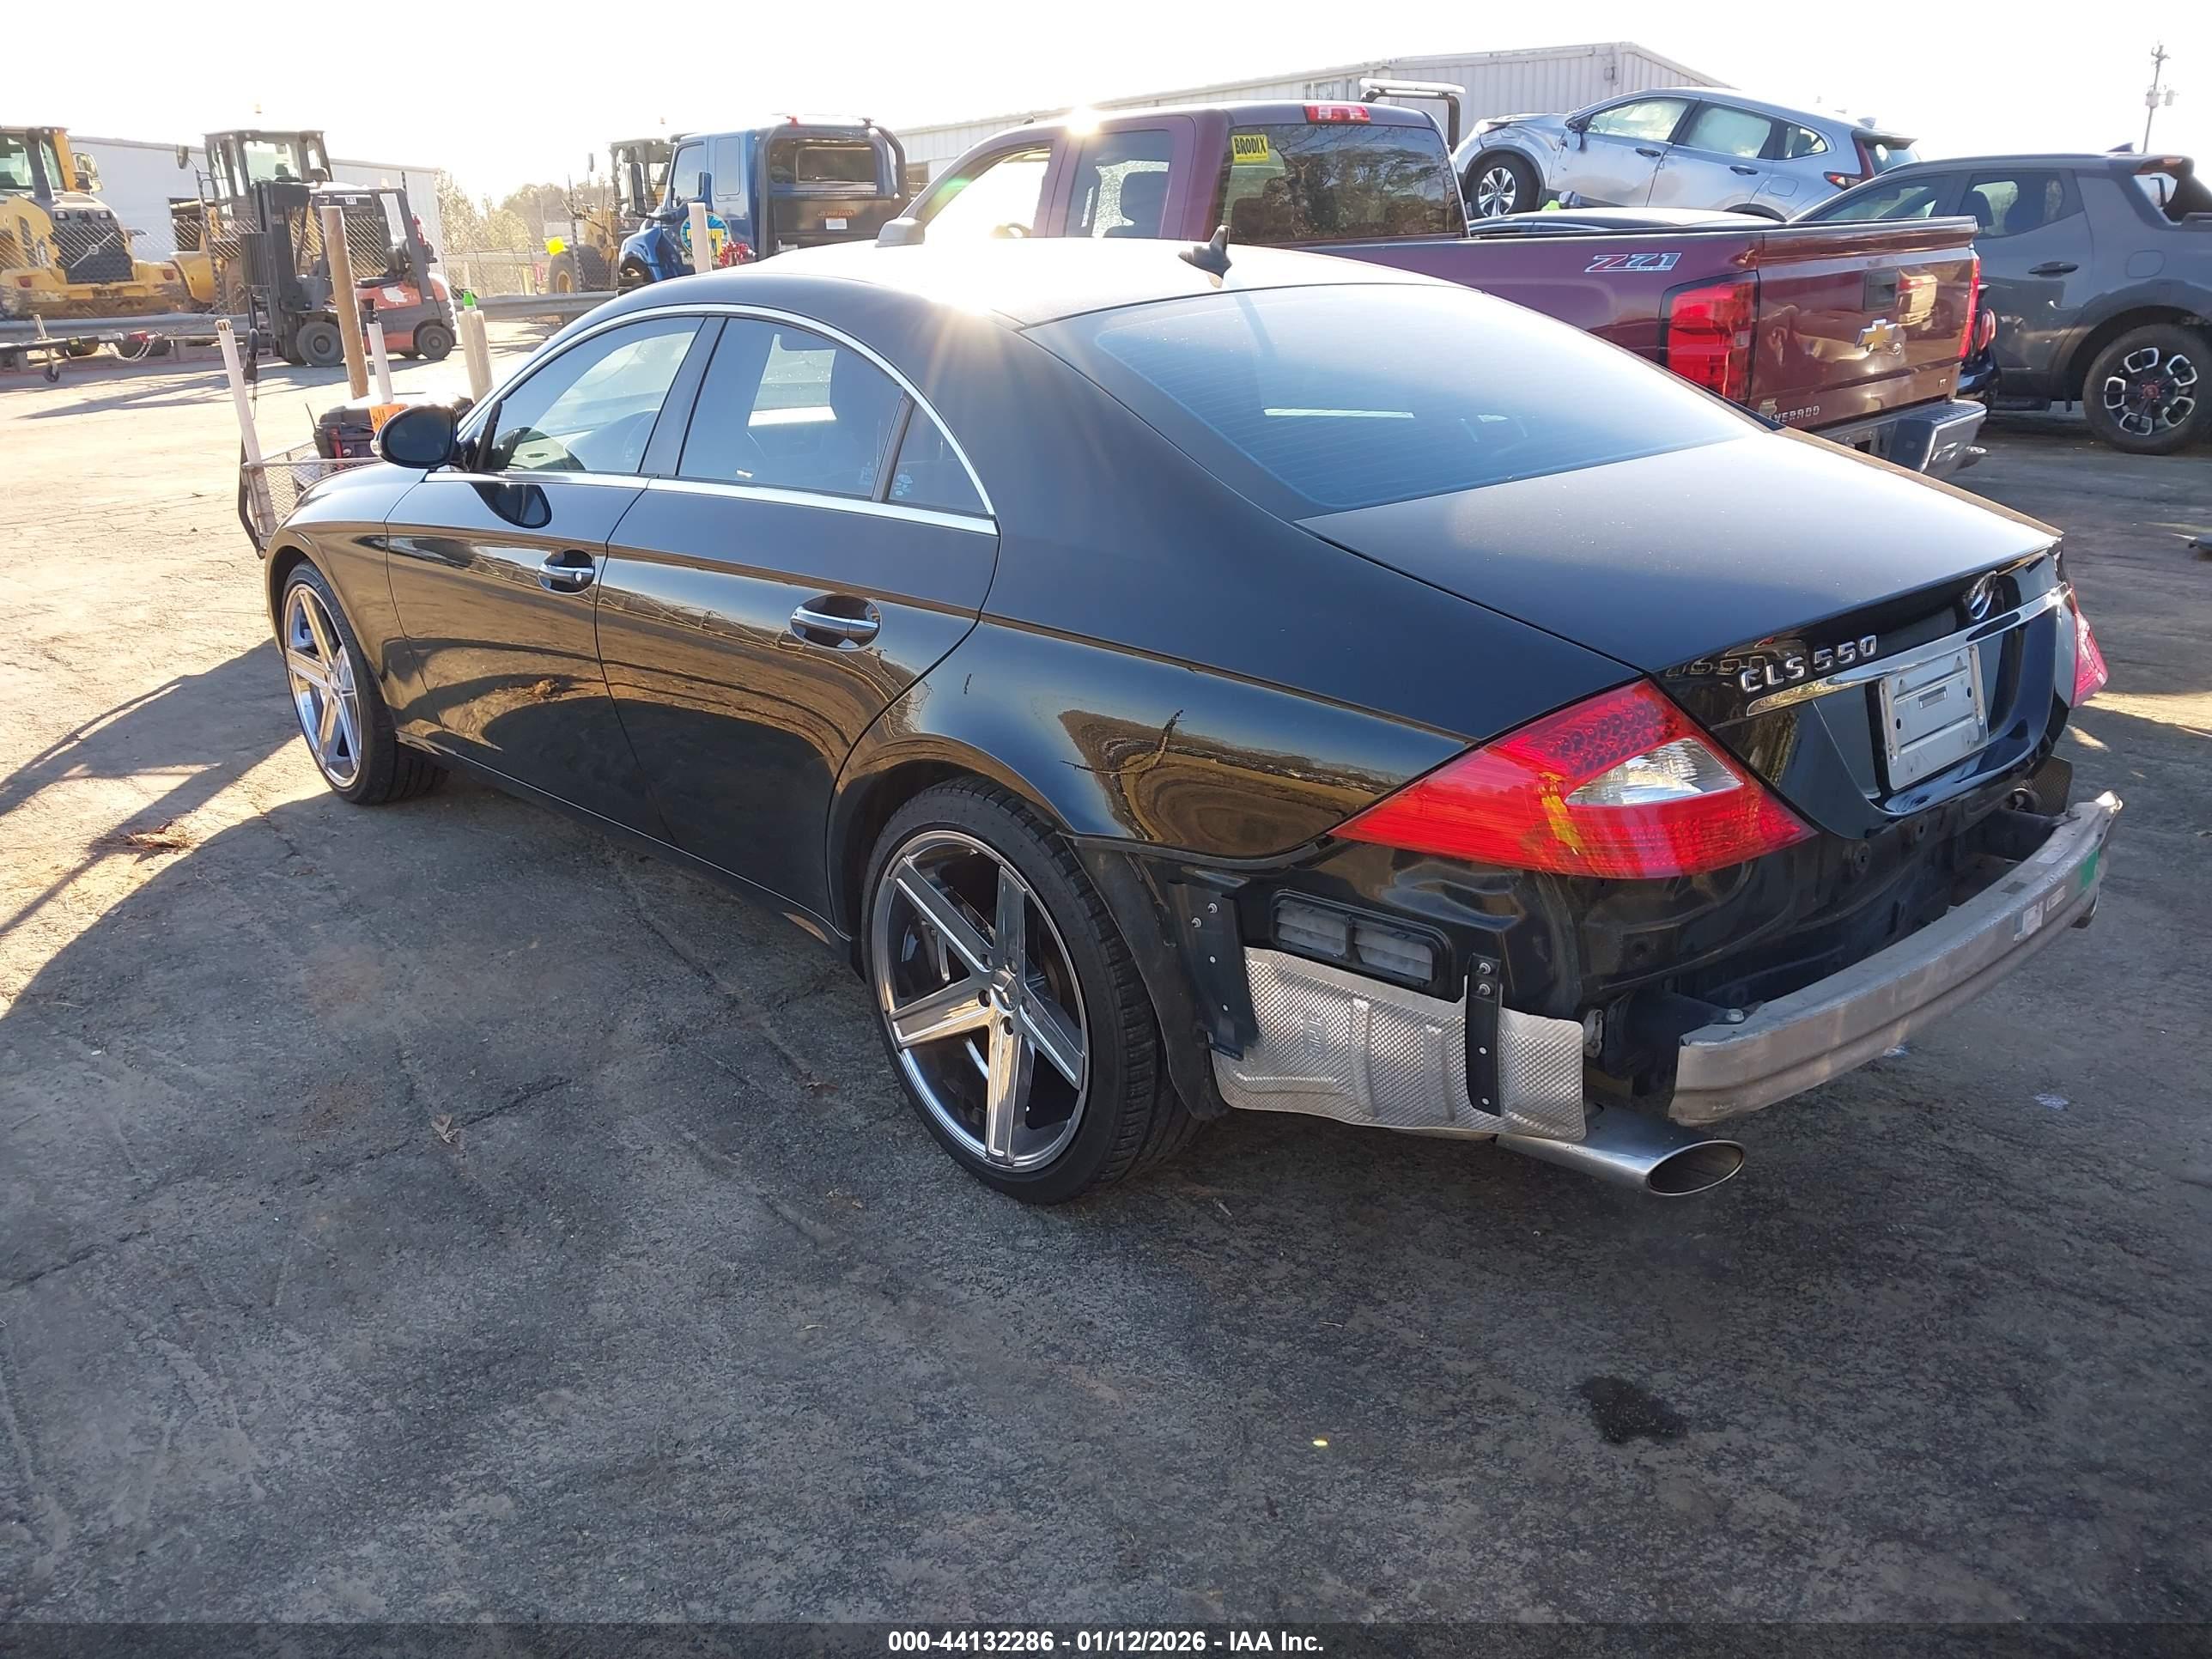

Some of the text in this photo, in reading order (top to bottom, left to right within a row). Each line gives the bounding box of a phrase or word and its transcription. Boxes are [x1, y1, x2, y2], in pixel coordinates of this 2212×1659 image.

[1234, 137, 1267, 155] BRODIX
[1584, 252, 1682, 273] Z71
[1741, 635, 1878, 693] CLS 550
